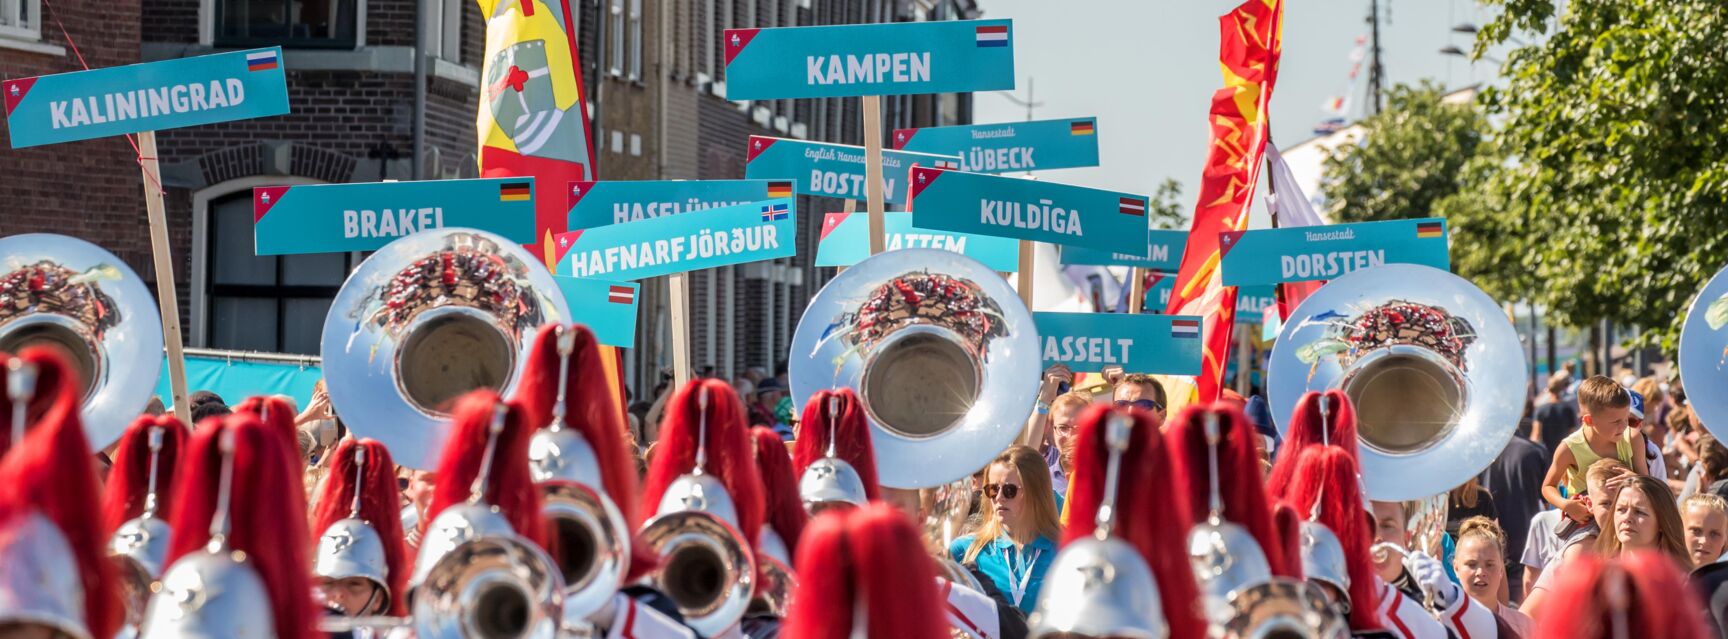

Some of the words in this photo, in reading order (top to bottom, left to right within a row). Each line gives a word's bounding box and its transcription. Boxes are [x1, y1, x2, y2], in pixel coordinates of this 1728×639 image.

[807, 52, 931, 85] KAMPEN
[50, 78, 245, 129] KALININGRAD
[971, 126, 1017, 139] Hansestadt
[804, 147, 836, 163] English
[881, 157, 901, 168] ities
[958, 146, 1036, 172] LÜBECK
[810, 169, 895, 200] BOSTN
[980, 199, 1083, 236] KULDĪGA
[885, 232, 967, 255] ATTEM
[1305, 228, 1356, 242] Hansestadt
[1281, 249, 1385, 279] DORSTEN
[1039, 335, 1134, 364] ASSELT
